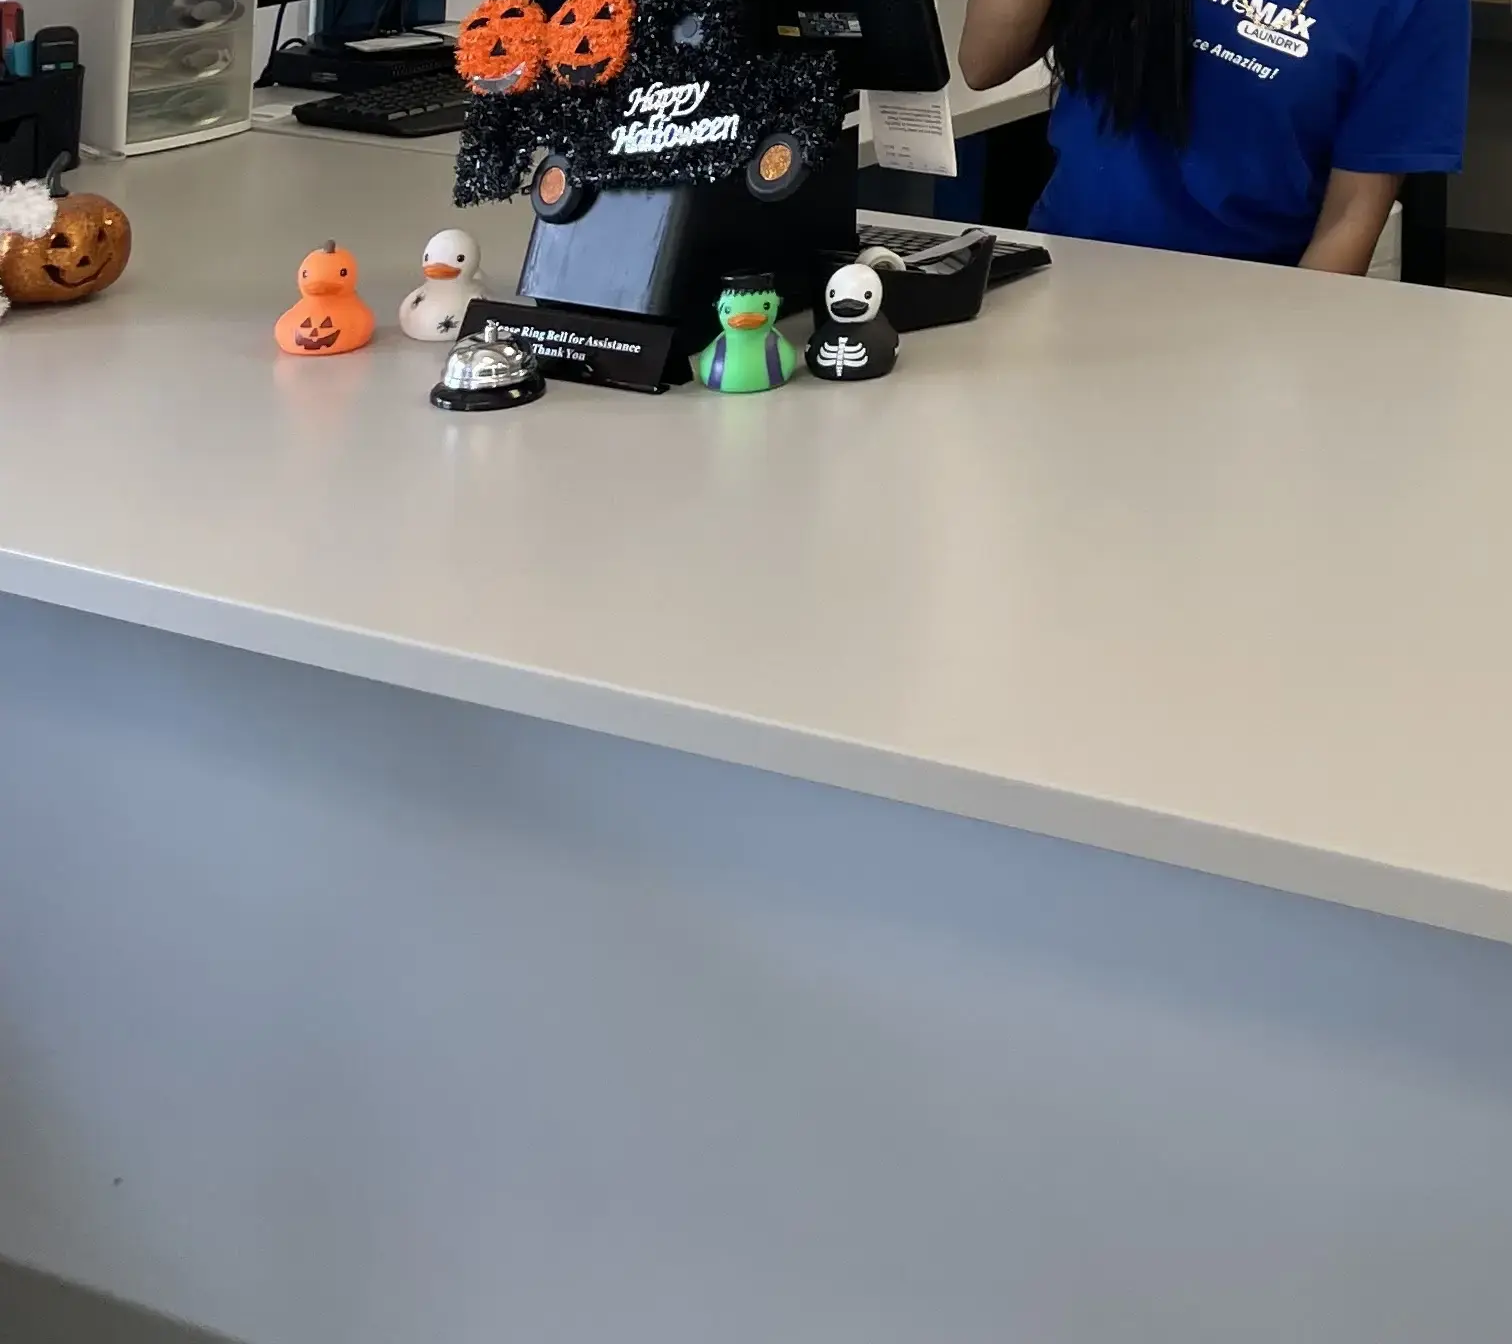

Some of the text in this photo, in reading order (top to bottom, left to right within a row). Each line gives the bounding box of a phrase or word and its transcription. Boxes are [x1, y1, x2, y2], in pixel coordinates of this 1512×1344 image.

[1243, 24, 1302, 53] LAUNDRY
[1210, 44, 1280, 80] Amazing!
[623, 80, 711, 119] Happy
[608, 113, 741, 155] Halloween
[521, 326, 546, 341] Ring
[546, 329, 568, 343] Bell
[568, 332, 585, 345] for
[585, 337, 641, 354] Assistance
[532, 343, 586, 361] Thank You
